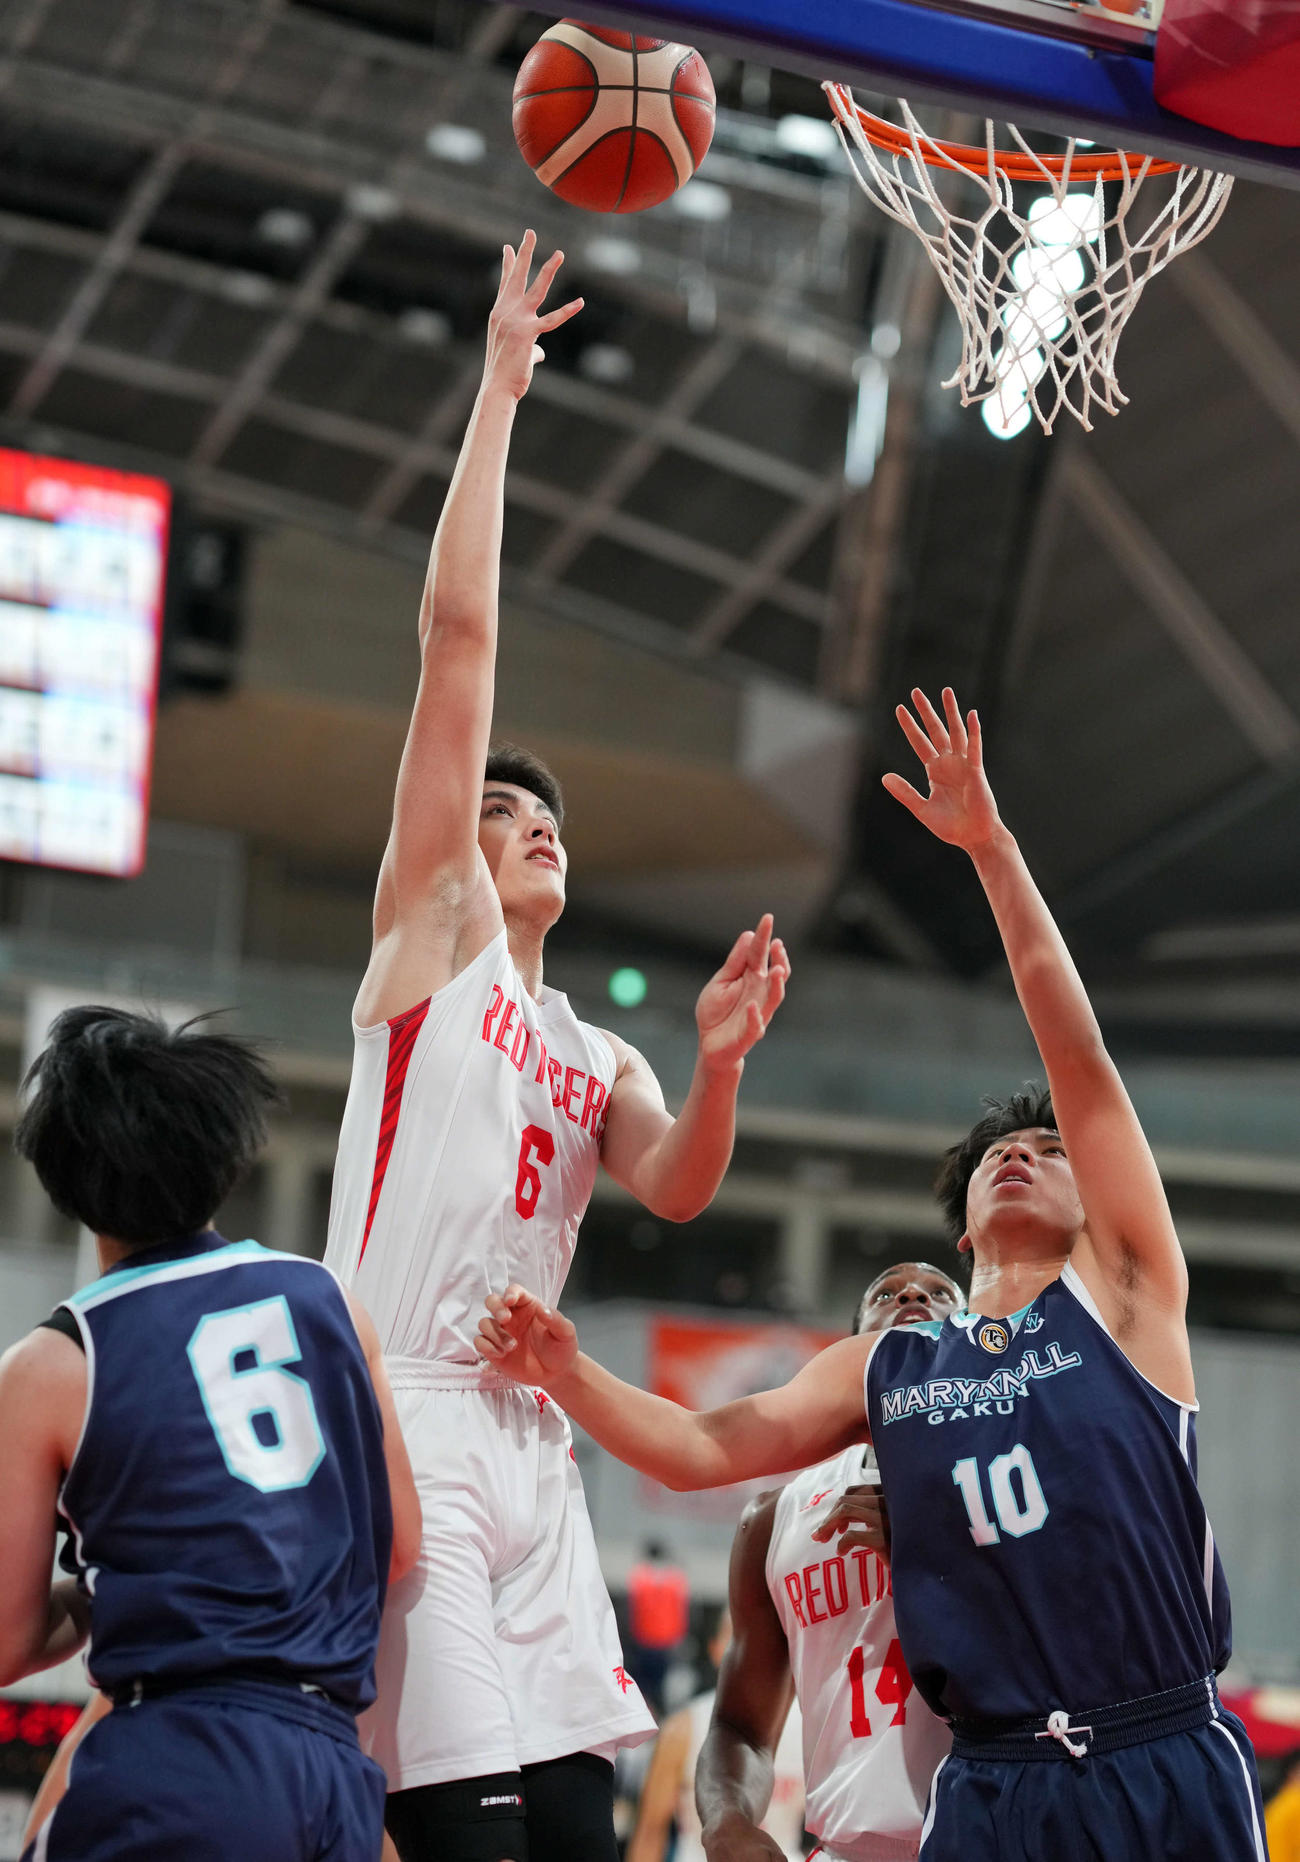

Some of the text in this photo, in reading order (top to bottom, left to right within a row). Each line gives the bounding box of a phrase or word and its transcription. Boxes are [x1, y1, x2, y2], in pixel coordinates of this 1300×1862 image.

[482, 984, 612, 1142] RED TGER
[515, 1124, 555, 1221] 6
[185, 1294, 327, 1494] 6
[952, 1443, 1050, 1546] 10
[784, 1556, 849, 1628] RED
[847, 1638, 913, 1739] 14
